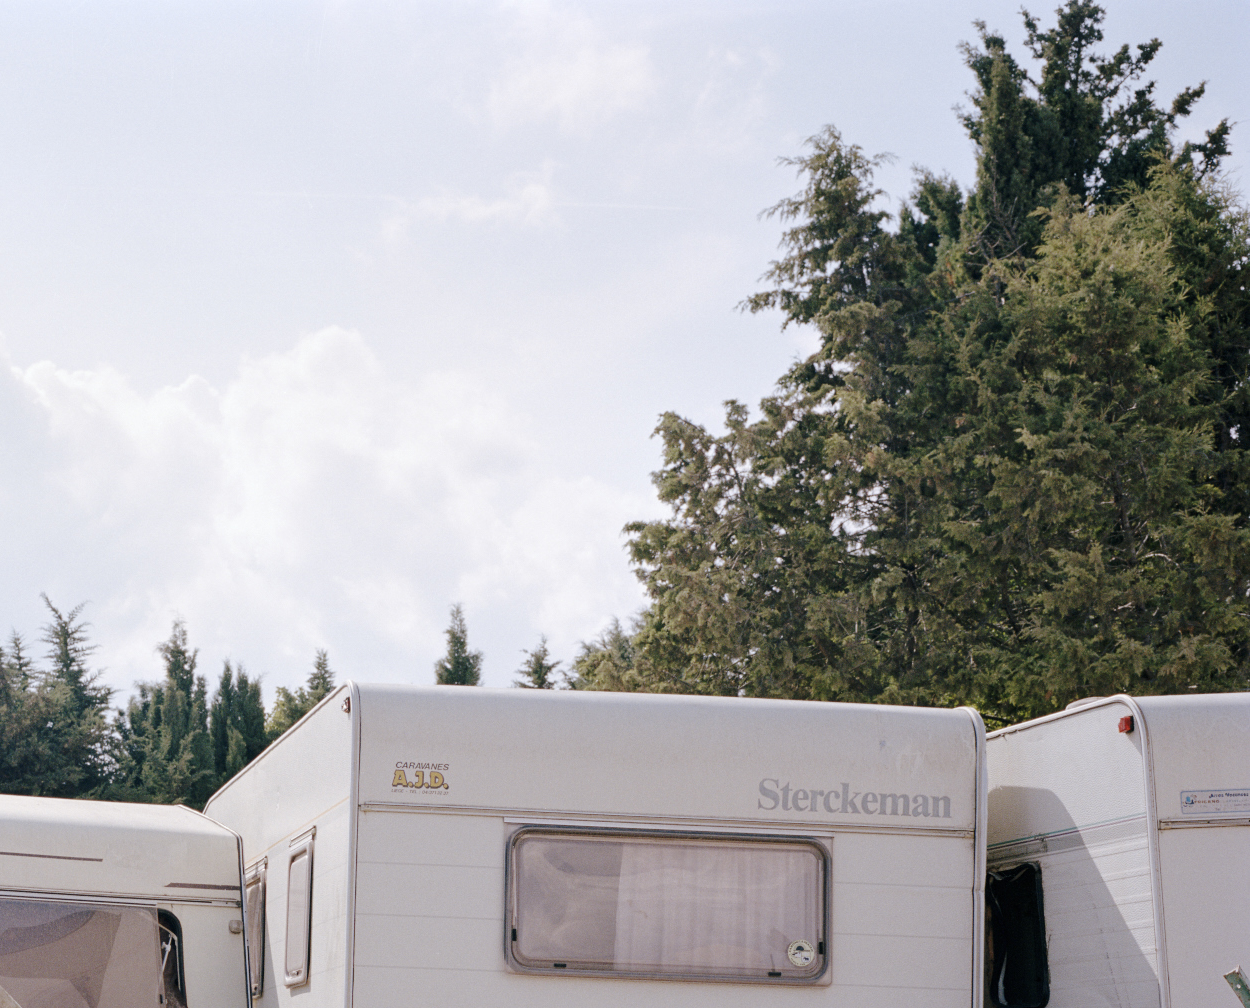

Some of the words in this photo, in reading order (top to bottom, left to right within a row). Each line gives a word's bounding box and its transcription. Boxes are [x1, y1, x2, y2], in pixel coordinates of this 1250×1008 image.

[395, 761, 450, 771] CARAVANES
[391, 769, 450, 790] A.J.D.
[757, 777, 953, 819] Sterckeman
